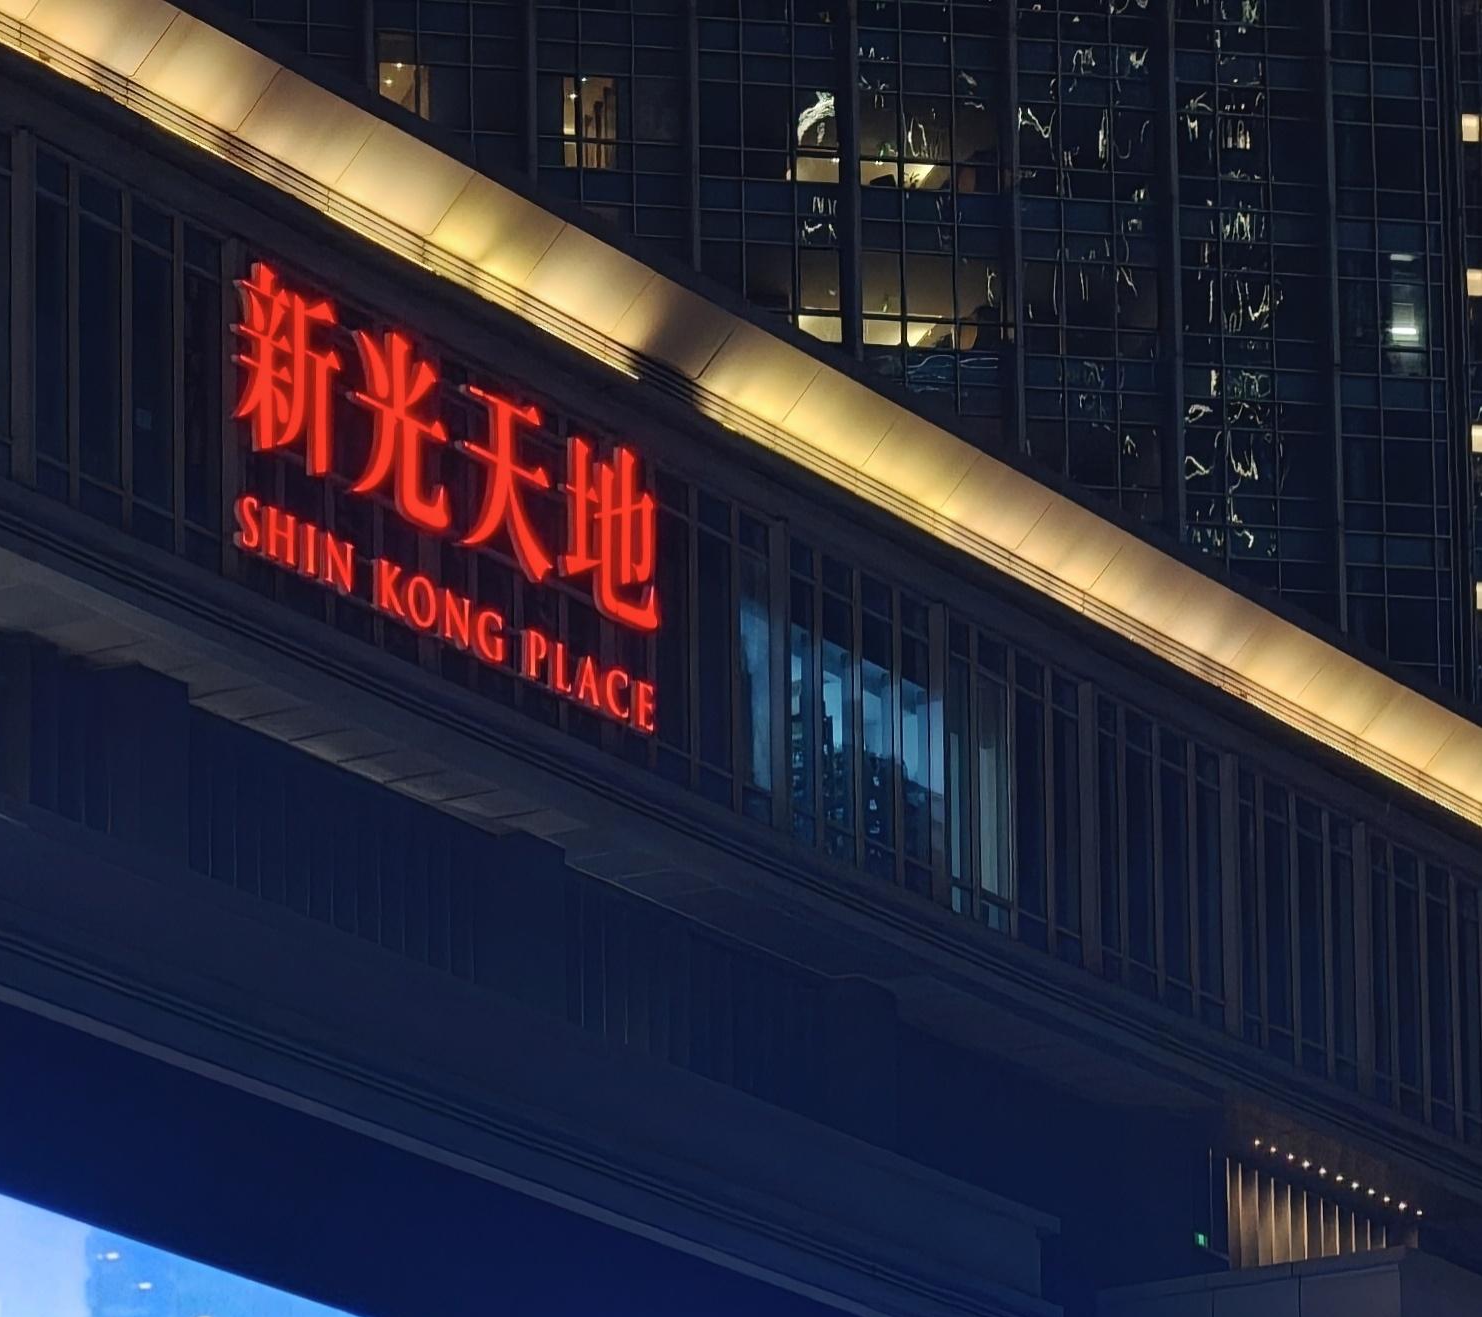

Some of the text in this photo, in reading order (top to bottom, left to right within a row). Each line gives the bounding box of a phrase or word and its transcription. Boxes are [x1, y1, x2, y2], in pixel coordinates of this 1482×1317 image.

[231, 262, 660, 629] 新光天地
[235, 495, 657, 734] SHIN KONG PLACE
